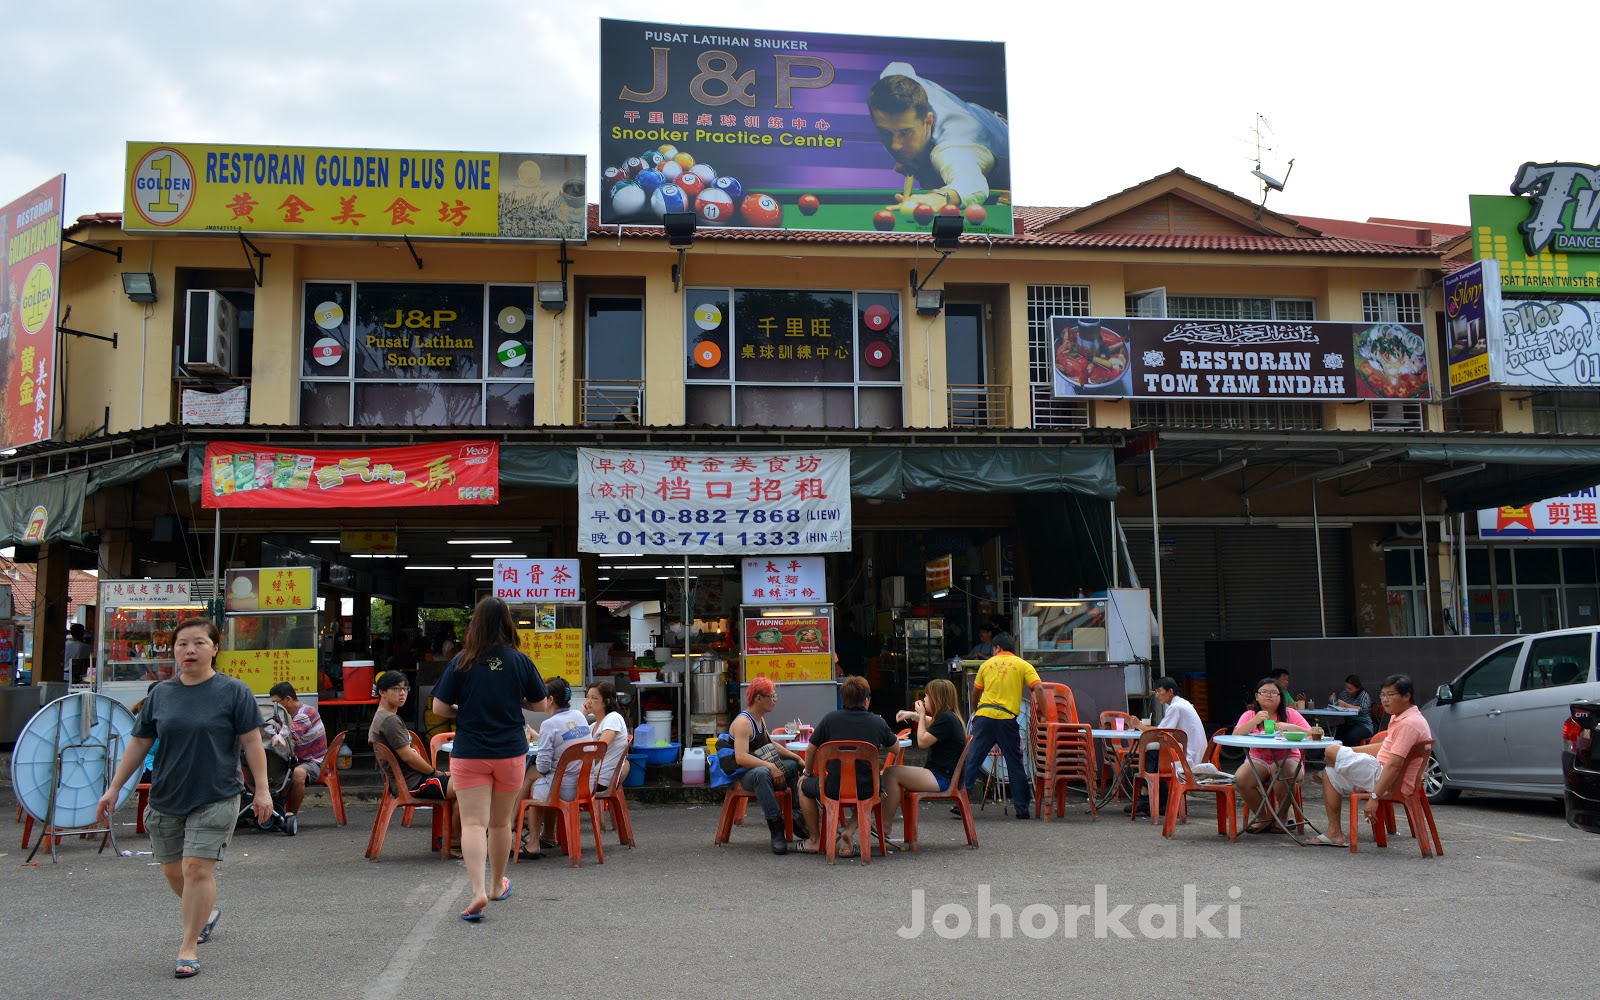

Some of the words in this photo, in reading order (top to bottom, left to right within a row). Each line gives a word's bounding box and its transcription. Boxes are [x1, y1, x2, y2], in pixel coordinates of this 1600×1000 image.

[645, 31, 689, 43] PUSAT
[693, 34, 749, 47] LATIHAN
[754, 38, 808, 51] SNUKER
[611, 126, 689, 142] Snooker
[695, 129, 773, 146] Practice
[779, 132, 843, 148] Center
[206, 152, 306, 186] RESTORAN
[315, 154, 390, 188] GOLDEN
[399, 157, 446, 190] PLUS
[454, 158, 491, 191] ONE
[136, 177, 191, 191] GOLDEN
[16, 197, 54, 230] RESTORAN
[705, 206, 717, 218] 11
[8, 227, 33, 268] GOLDEN
[31, 219, 46, 255] PLUS
[45, 213, 59, 249] ONE
[1559, 235, 1600, 248] DANCE
[1521, 275, 1554, 287] TARIAN
[1555, 276, 1595, 288] TWISTER
[22, 286, 52, 310] GOLDEN
[1447, 280, 1482, 318] Glory
[384, 309, 457, 329] J&P
[757, 316, 832, 338] 千里旺
[366, 335, 409, 349] Pusat
[415, 335, 474, 350] Latihan
[1549, 322, 1593, 355] KPOP
[387, 353, 452, 367] Snooker
[1179, 350, 1311, 371] RESTORAN
[1508, 346, 1551, 369] DANCE
[1143, 373, 1199, 393] TOM
[1205, 374, 1261, 394] YAM
[1267, 374, 1346, 394] INDAH
[1451, 370, 1474, 384] 012-796
[1474, 363, 1488, 376] 8575
[466, 447, 489, 456] Yeo's
[654, 476, 828, 502] 档口招租
[591, 510, 611, 523] 早
[617, 508, 727, 524] 010-882
[735, 509, 801, 524] 7868
[806, 508, 841, 522] (LIEW)
[591, 532, 610, 545] 晚
[617, 531, 724, 546] 013-771
[736, 531, 800, 546] 1333
[502, 564, 573, 585] 肉骨茶
[764, 559, 802, 573] 太平
[497, 588, 522, 598] BAK
[526, 588, 550, 598] KUT
[554, 588, 576, 598] TEH
